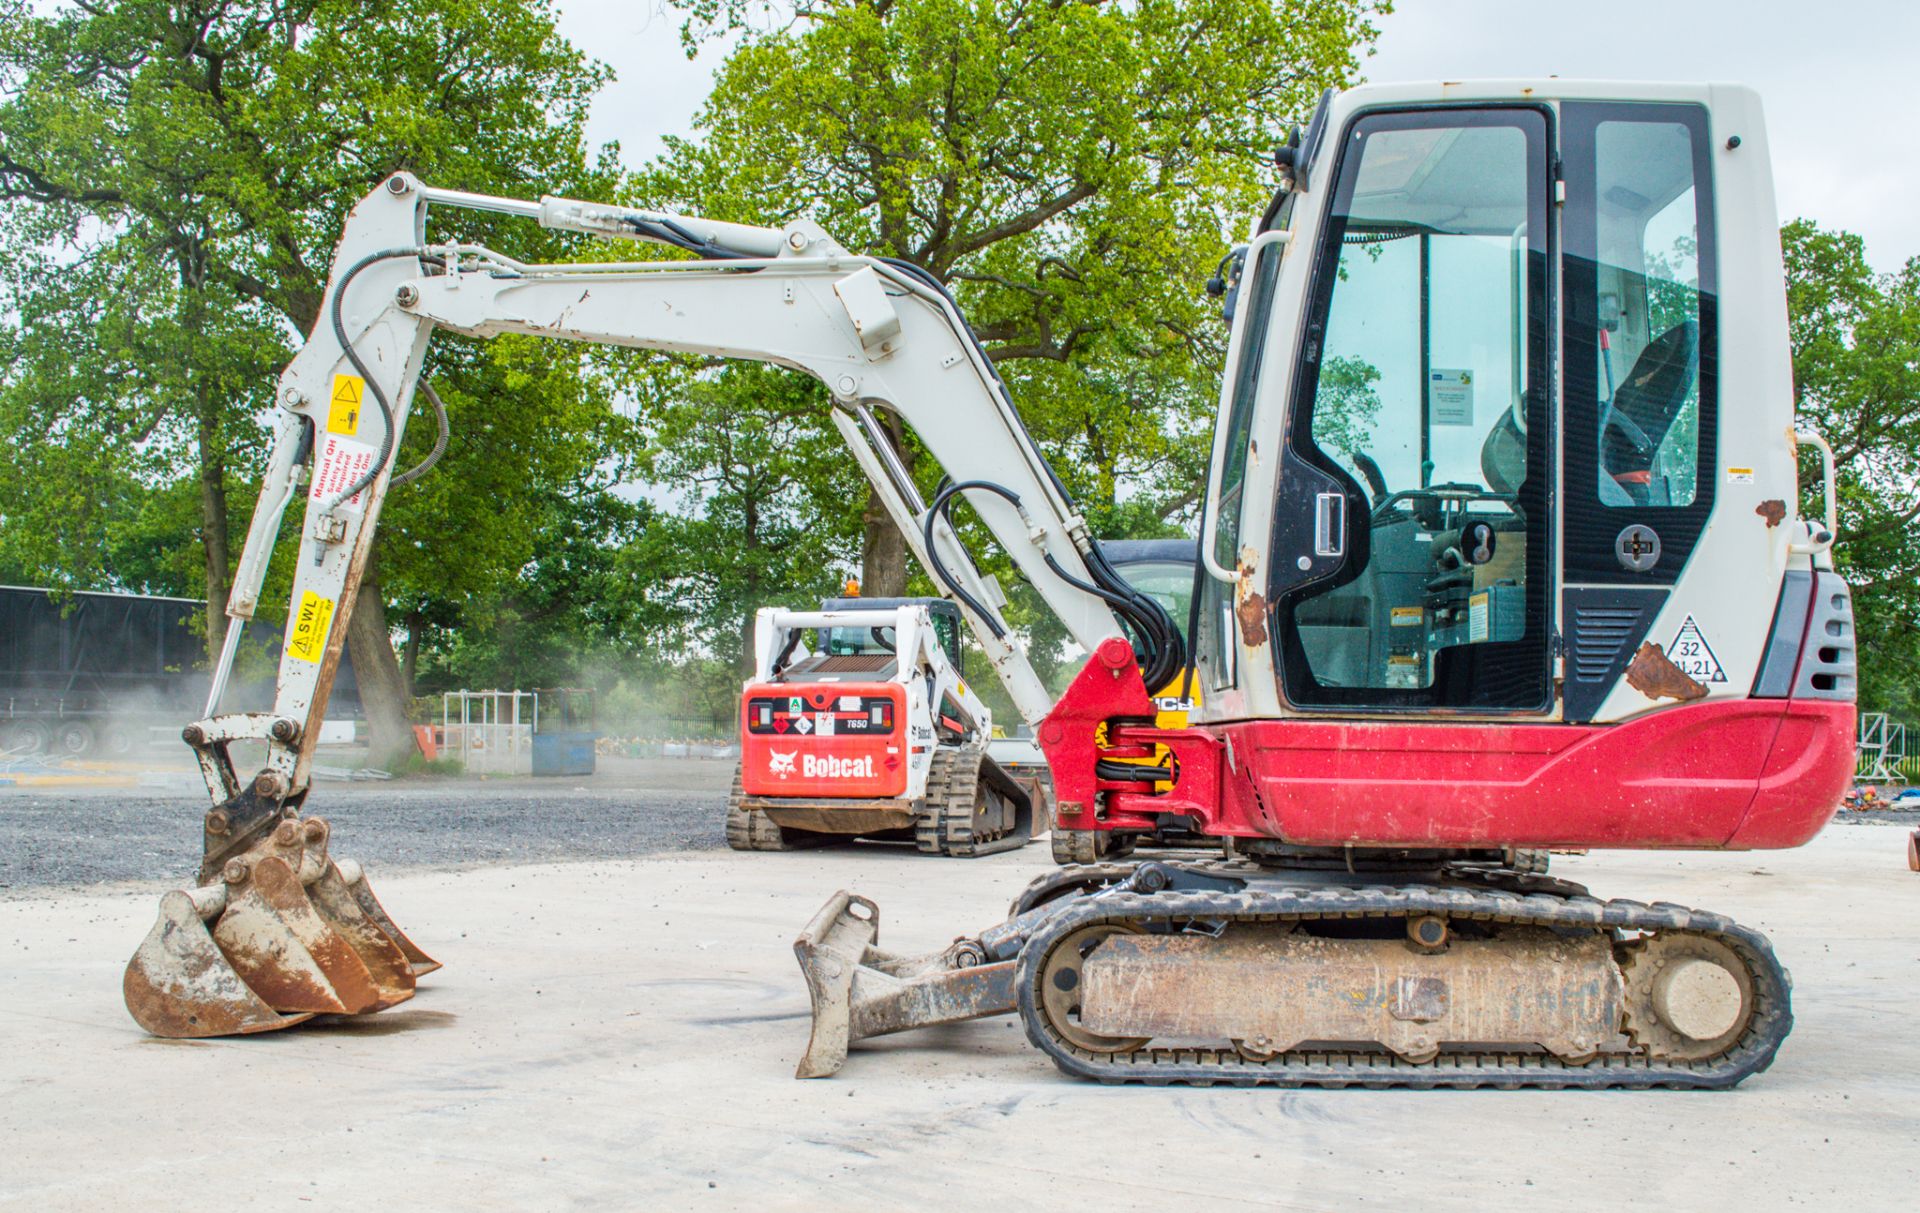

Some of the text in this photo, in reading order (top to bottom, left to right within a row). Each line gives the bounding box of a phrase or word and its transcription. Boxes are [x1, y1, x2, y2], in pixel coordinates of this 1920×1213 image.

[314, 439, 337, 498] Manual QH
[327, 450, 345, 493] Safety Pin
[353, 452, 363, 470] Use
[361, 452, 371, 470] One
[335, 454, 352, 493] Required
[298, 600, 317, 633] SWL
[1680, 641, 1699, 656] 32
[847, 719, 868, 729] T650
[803, 754, 873, 778] Bobcat
